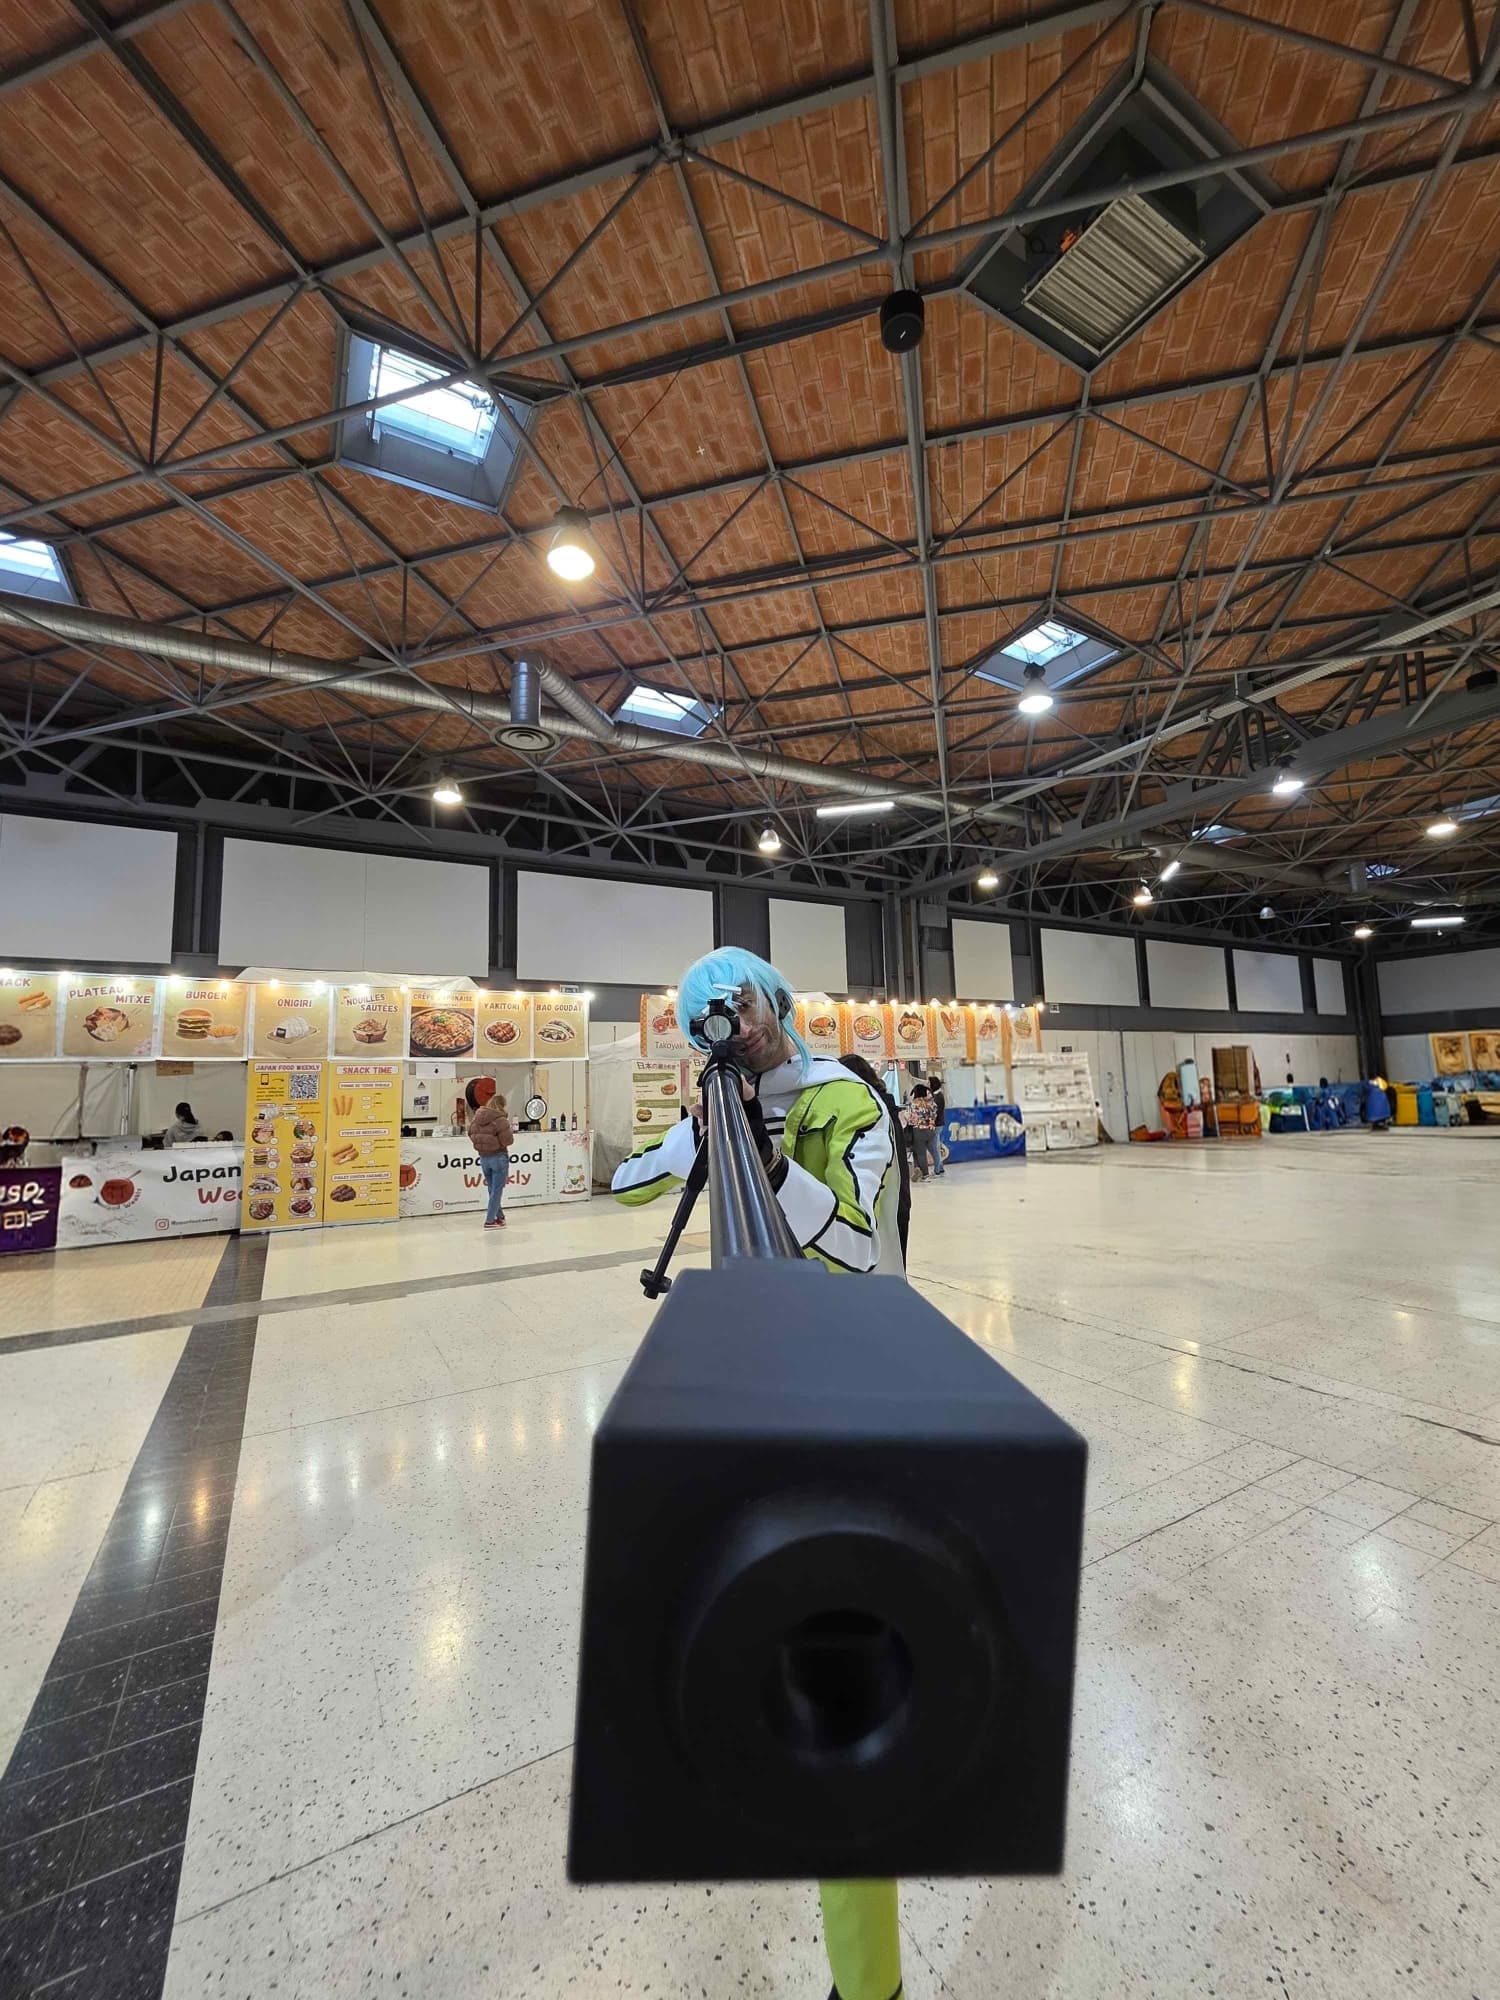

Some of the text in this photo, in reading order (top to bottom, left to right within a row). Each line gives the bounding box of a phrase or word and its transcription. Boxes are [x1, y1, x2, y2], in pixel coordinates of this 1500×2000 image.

[185, 991, 228, 1000] BURGER
[277, 999, 312, 1008] ONIGIRI
[484, 1002, 520, 1011] YAKITORI
[536, 1003, 552, 1012] BAO
[655, 1041, 685, 1051] Takoyaki
[342, 1066, 393, 1074] SNACK TIME
[437, 1148, 543, 1170] Jap ood
[162, 1165, 242, 1183] Japan
[464, 1169, 532, 1188] Wkly
[197, 1186, 243, 1205] We
